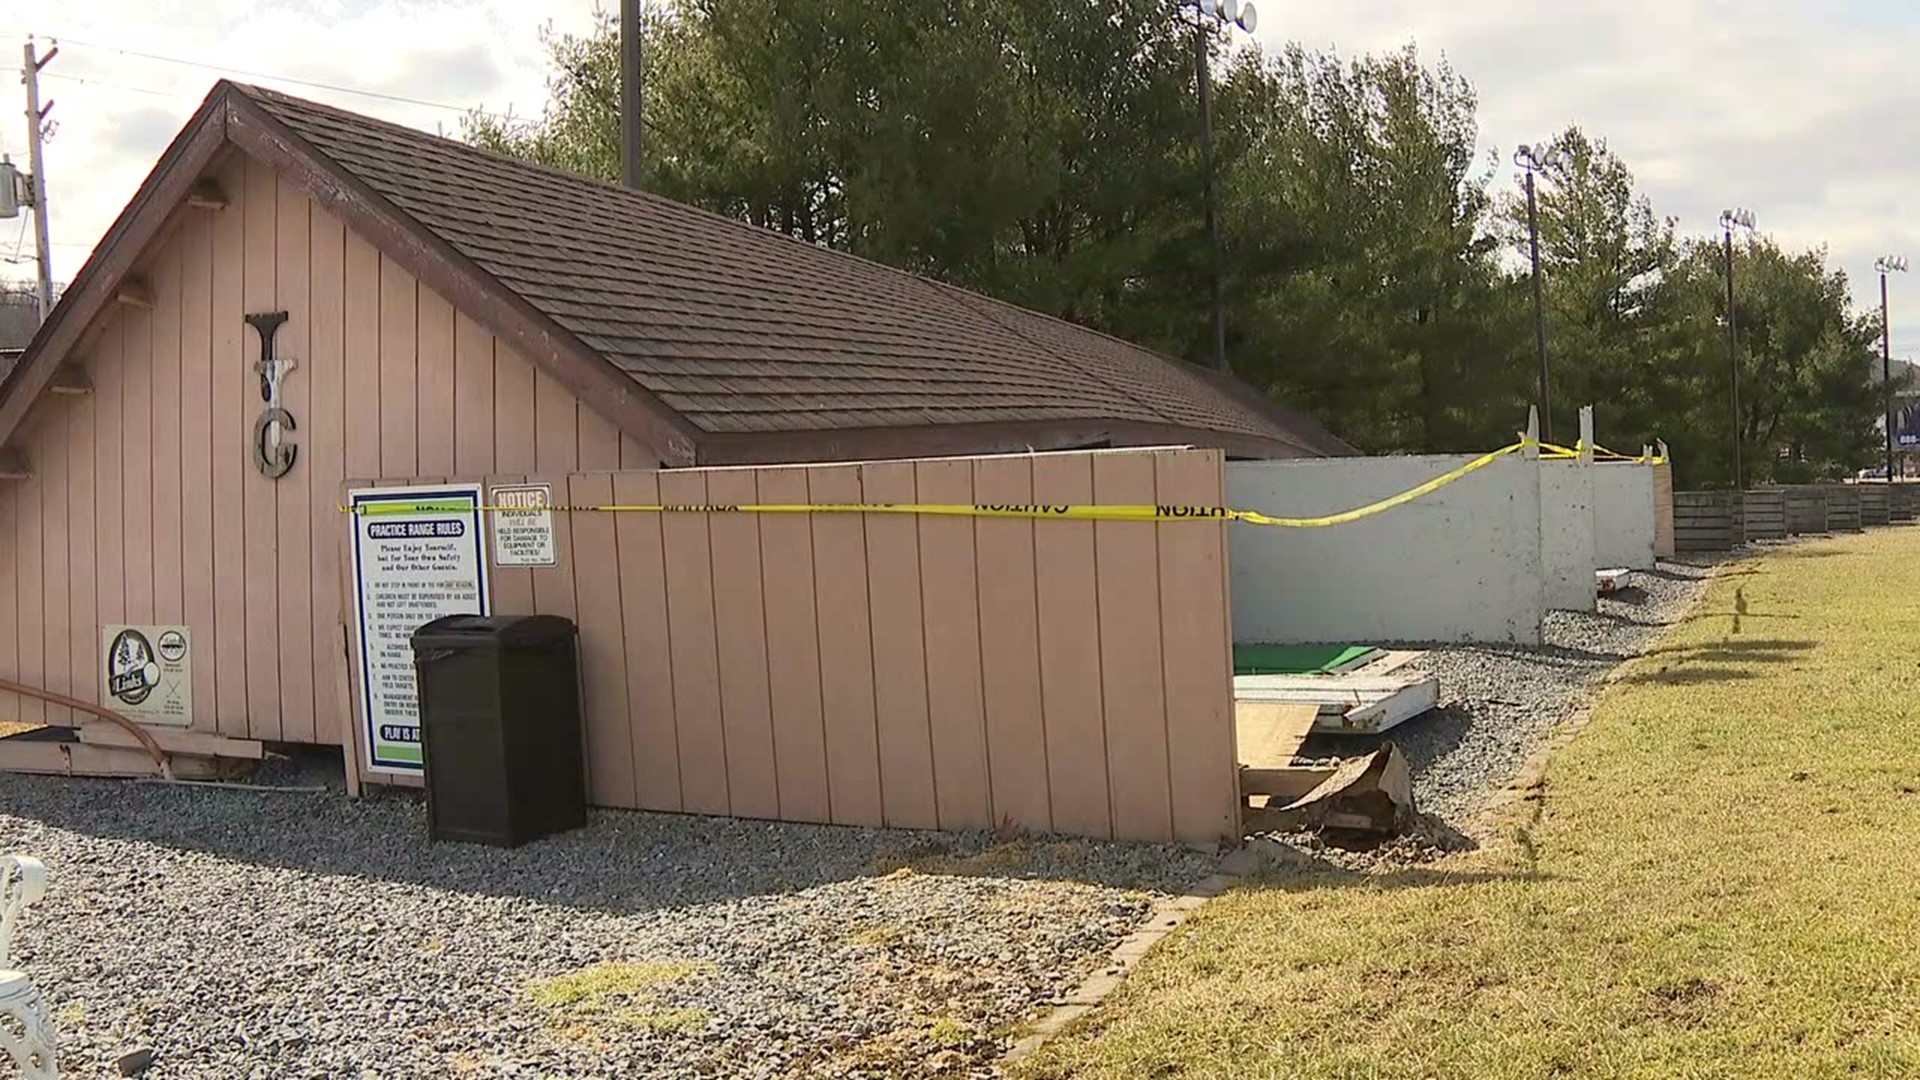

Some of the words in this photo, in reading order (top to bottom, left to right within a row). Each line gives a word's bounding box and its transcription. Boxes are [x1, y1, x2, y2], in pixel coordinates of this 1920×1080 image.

[498, 491, 544, 508] NOTICE
[370, 524, 406, 537] PRACTICE
[408, 523, 435, 536] RANGE
[436, 522, 462, 535] RULES
[385, 726, 401, 740] PLAY
[402, 726, 408, 740] IS
